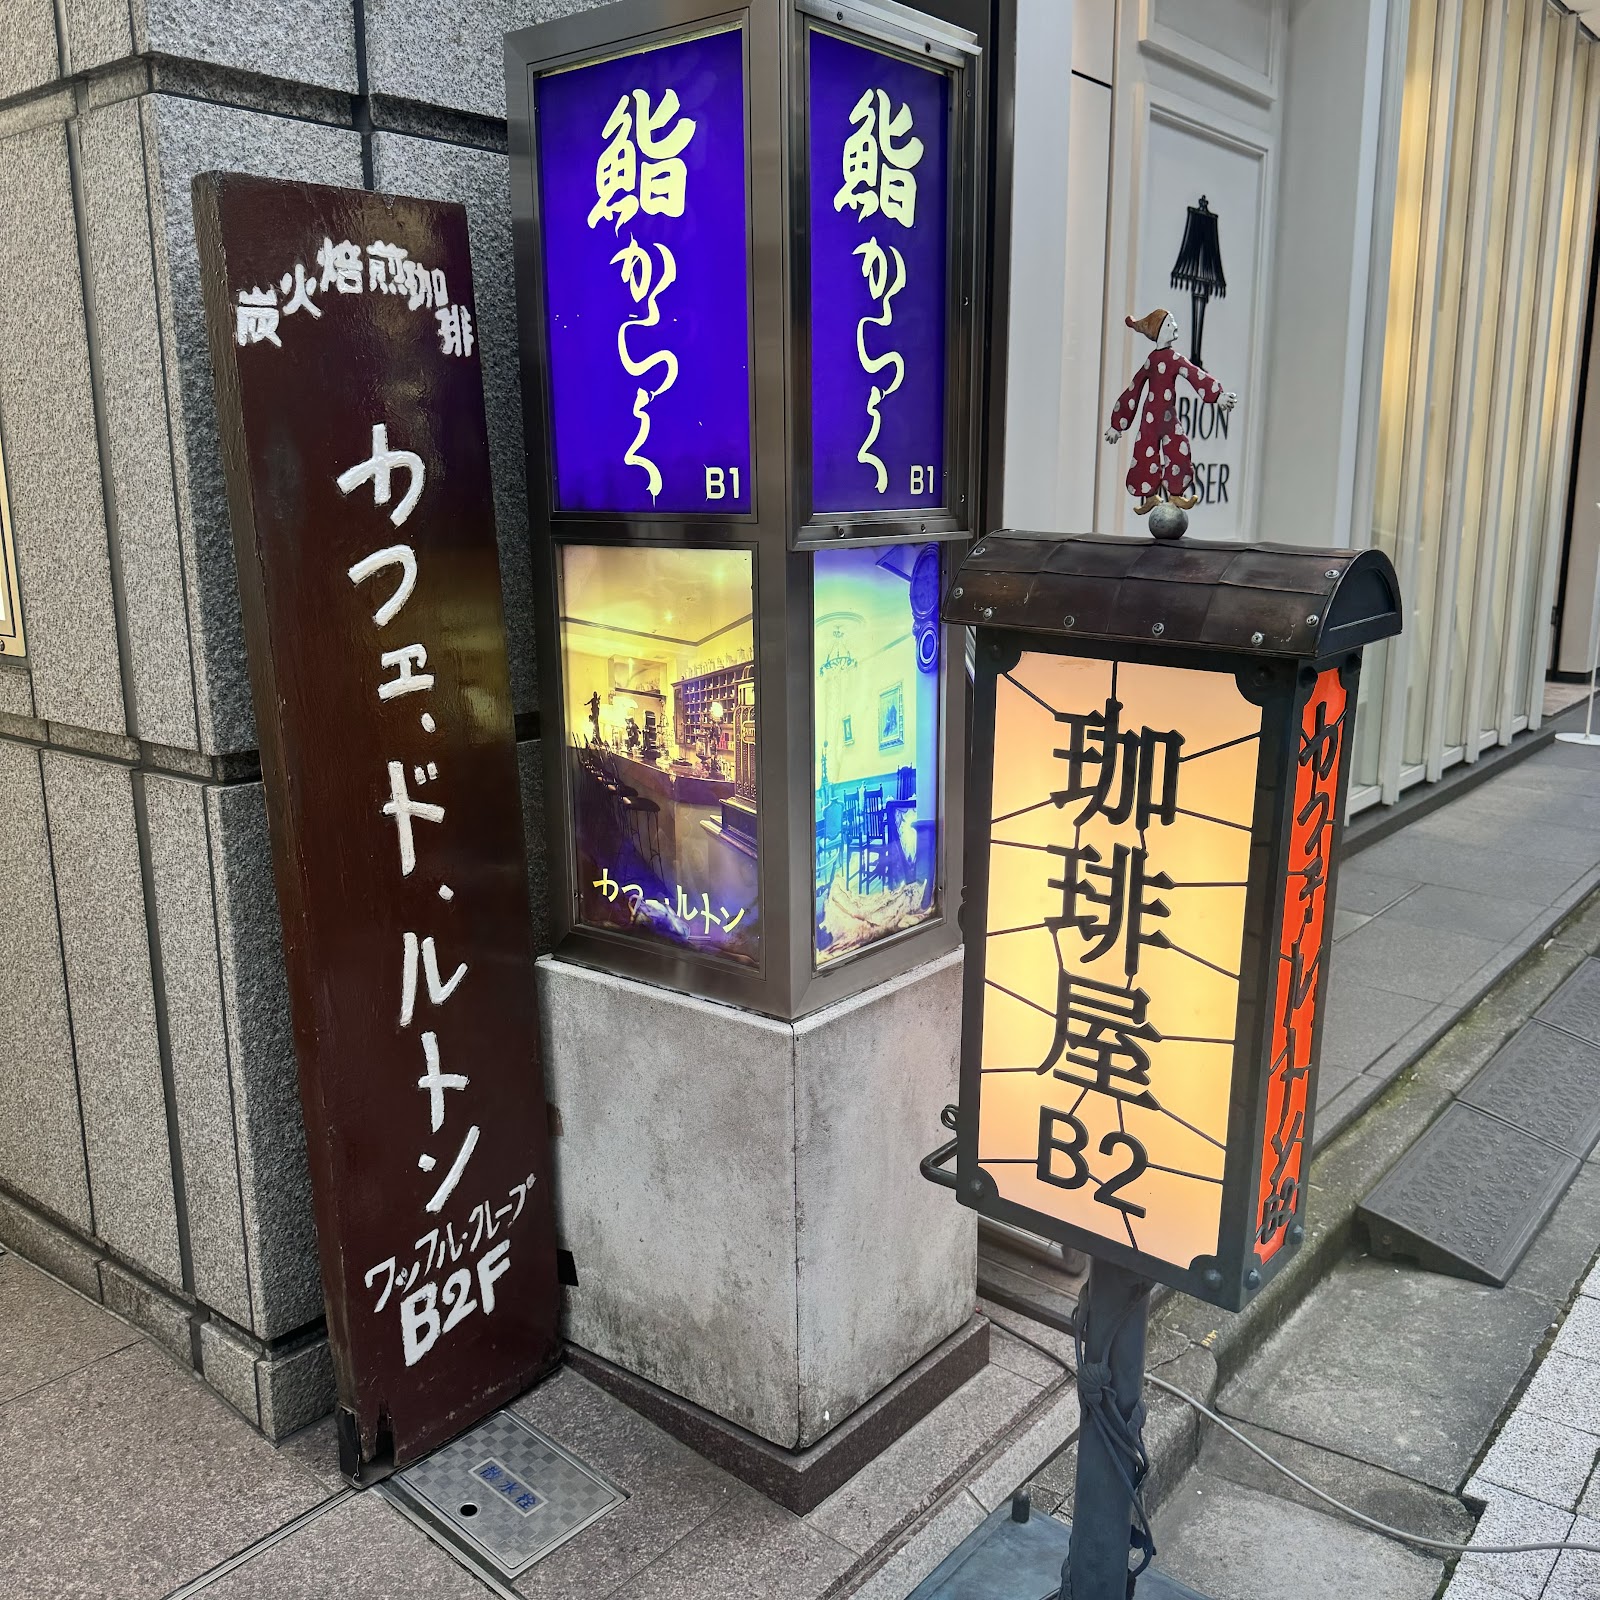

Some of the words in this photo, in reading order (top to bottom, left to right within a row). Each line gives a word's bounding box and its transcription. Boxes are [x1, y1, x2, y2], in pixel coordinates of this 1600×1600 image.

[237, 236, 474, 357] 炭火焙煎珈琲
[1178, 396, 1229, 440] BION
[705, 467, 739, 500] B1
[910, 465, 935, 496] B1
[1036, 698, 1185, 1111] 珈琲屋
[1037, 1105, 1146, 1219] B2
[1261, 1176, 1297, 1245] B2
[364, 1172, 537, 1313] ワッフル・クレープ
[400, 1239, 511, 1367] B2F
